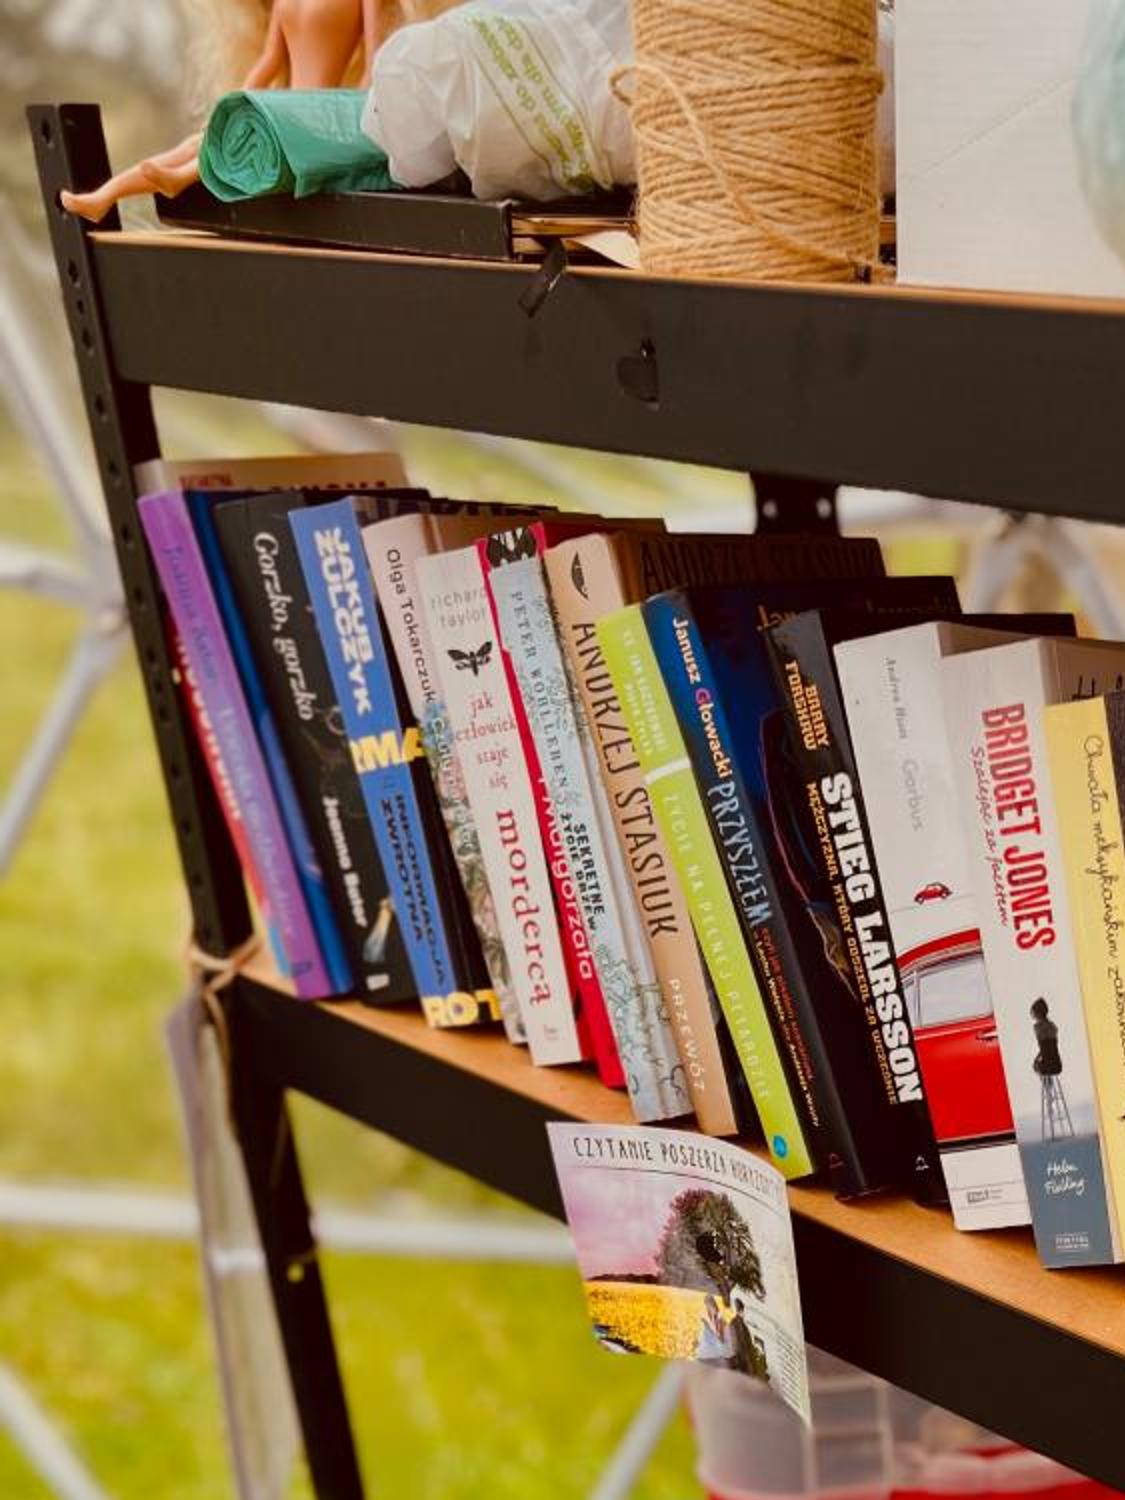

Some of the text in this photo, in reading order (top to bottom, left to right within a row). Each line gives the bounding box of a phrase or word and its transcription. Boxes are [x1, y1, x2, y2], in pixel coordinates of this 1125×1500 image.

[250, 527, 321, 723] Gorzko, gorzko
[311, 525, 373, 716] ŻULCZYK
[330, 525, 376, 663] JAKUB
[383, 546, 435, 704] Olga Tokarczuk
[508, 591, 539, 660] PETER
[470, 691, 493, 717] jak
[670, 613, 778, 928] Janusz Głowacki PRZYSZŁEM
[782, 659, 820, 752] FORSHAW
[802, 682, 832, 748] BARRY
[570, 617, 682, 940] ANDRZEJ STASIUK
[901, 758, 925, 832] Garbus
[969, 745, 999, 823] Szalejąc
[985, 826, 1001, 854] za
[980, 701, 1061, 950] BRIDGET JONES
[321, 793, 375, 928] Joanna Bator
[379, 797, 426, 942] ZWROTNA
[392, 792, 448, 986] INFORMACJA
[496, 806, 559, 1006] mordercą
[536, 792, 600, 980] Małgorzata
[571, 821, 606, 916] SEKRETNE
[818, 770, 923, 1105] STIEG LARSSON
[572, 1136, 653, 1161] CZYTANIE
[660, 1142, 727, 1173] POSZERZA
